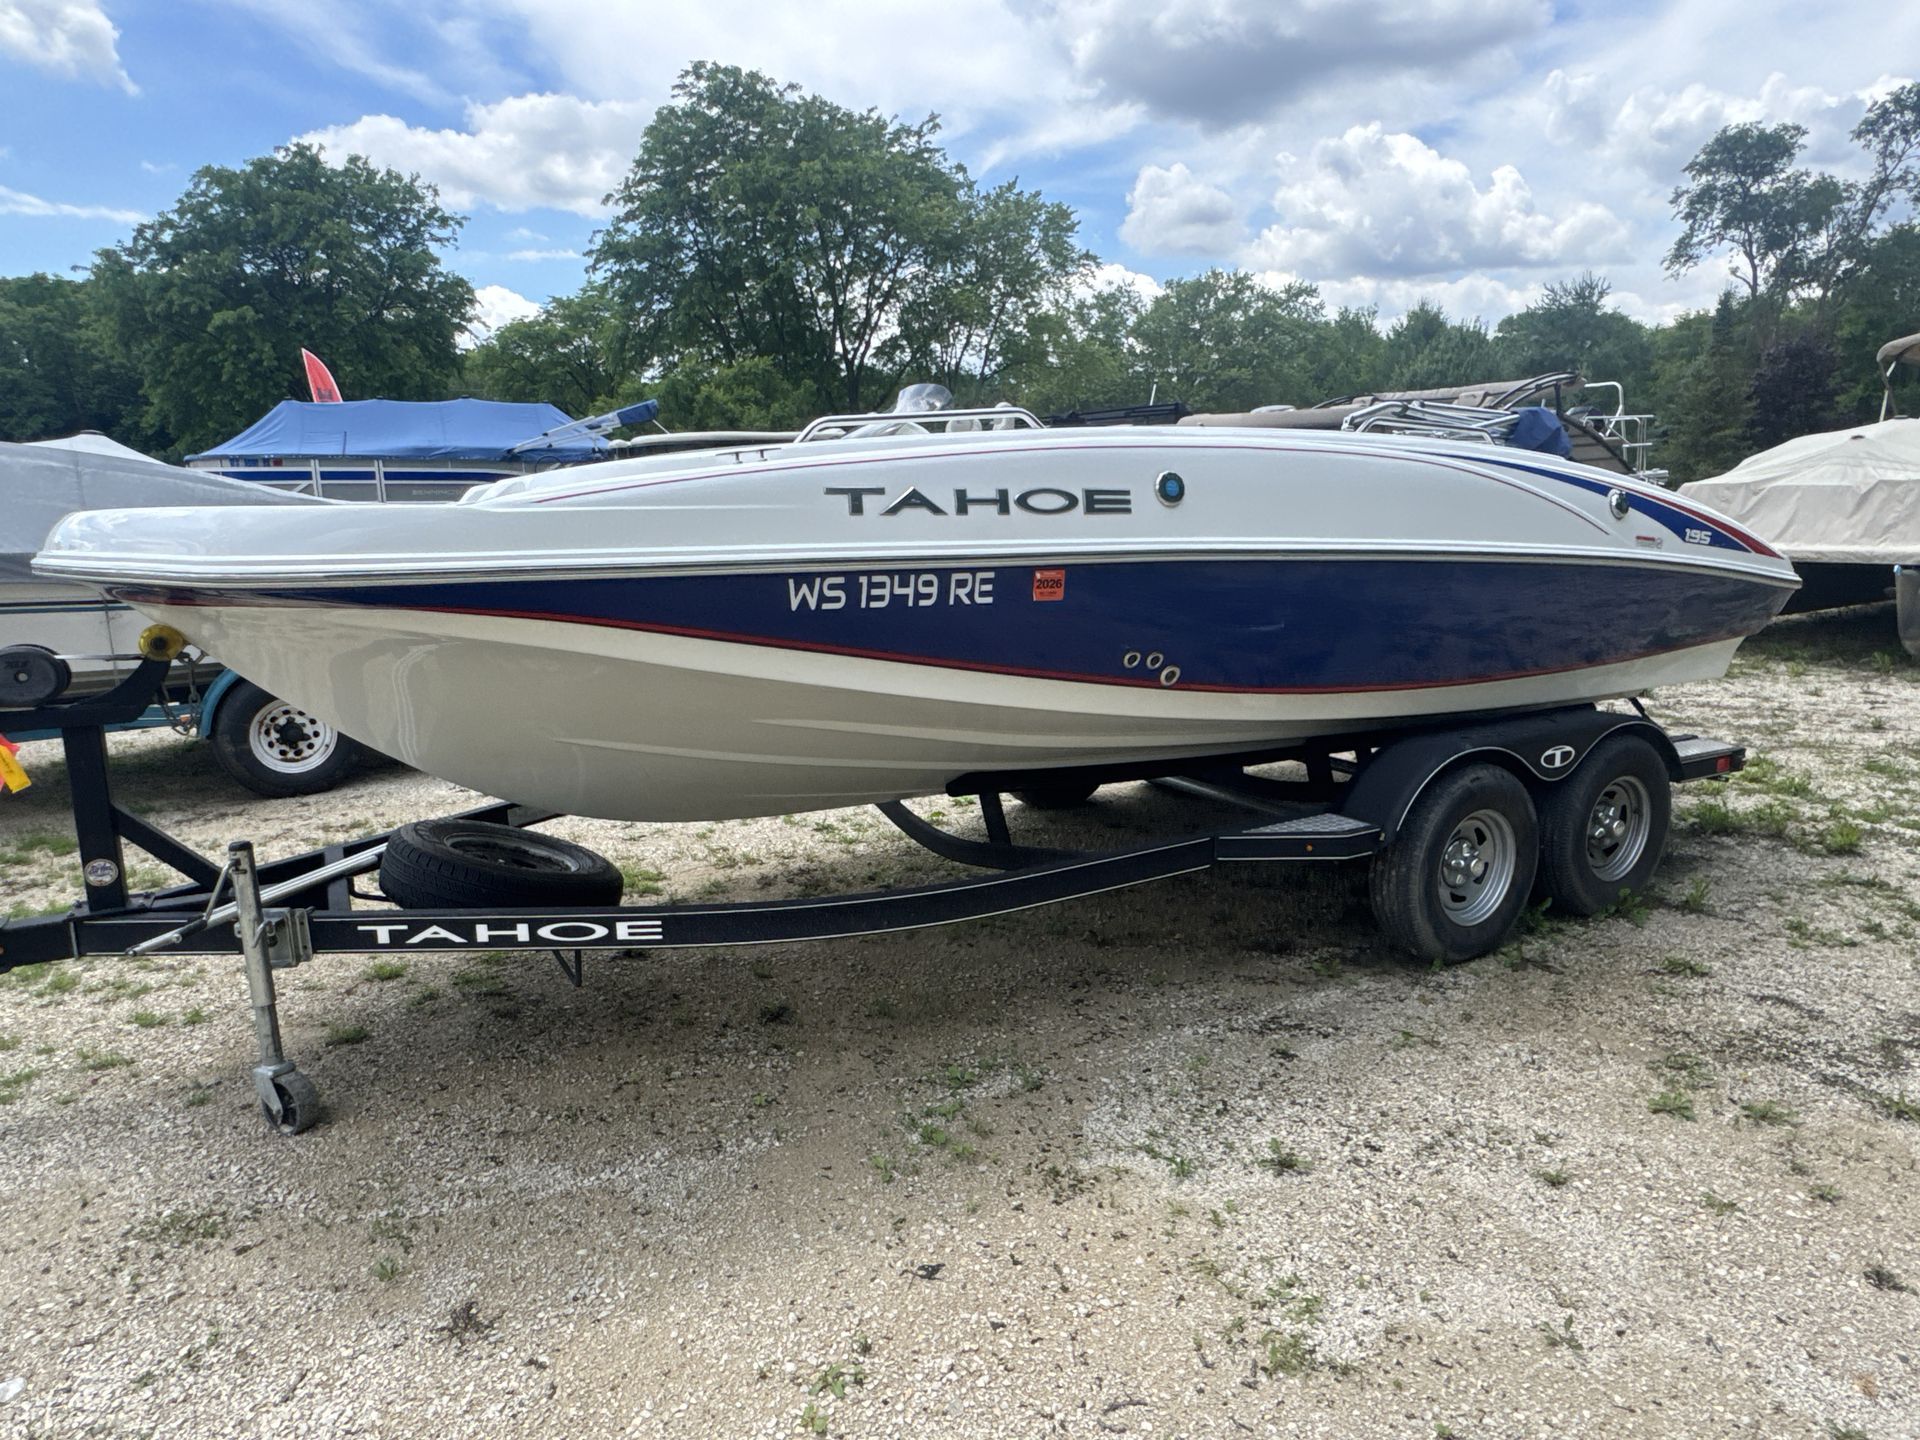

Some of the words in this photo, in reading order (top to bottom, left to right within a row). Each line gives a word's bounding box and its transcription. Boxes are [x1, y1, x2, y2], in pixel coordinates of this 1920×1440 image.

[823, 486, 1132, 516] TAHOE
[1685, 528, 1712, 545] 195
[788, 576, 847, 612] WS
[858, 574, 939, 609] 1349
[949, 571, 995, 606] RE
[1036, 579, 1063, 590] 2026
[357, 920, 664, 945] TAHOE
